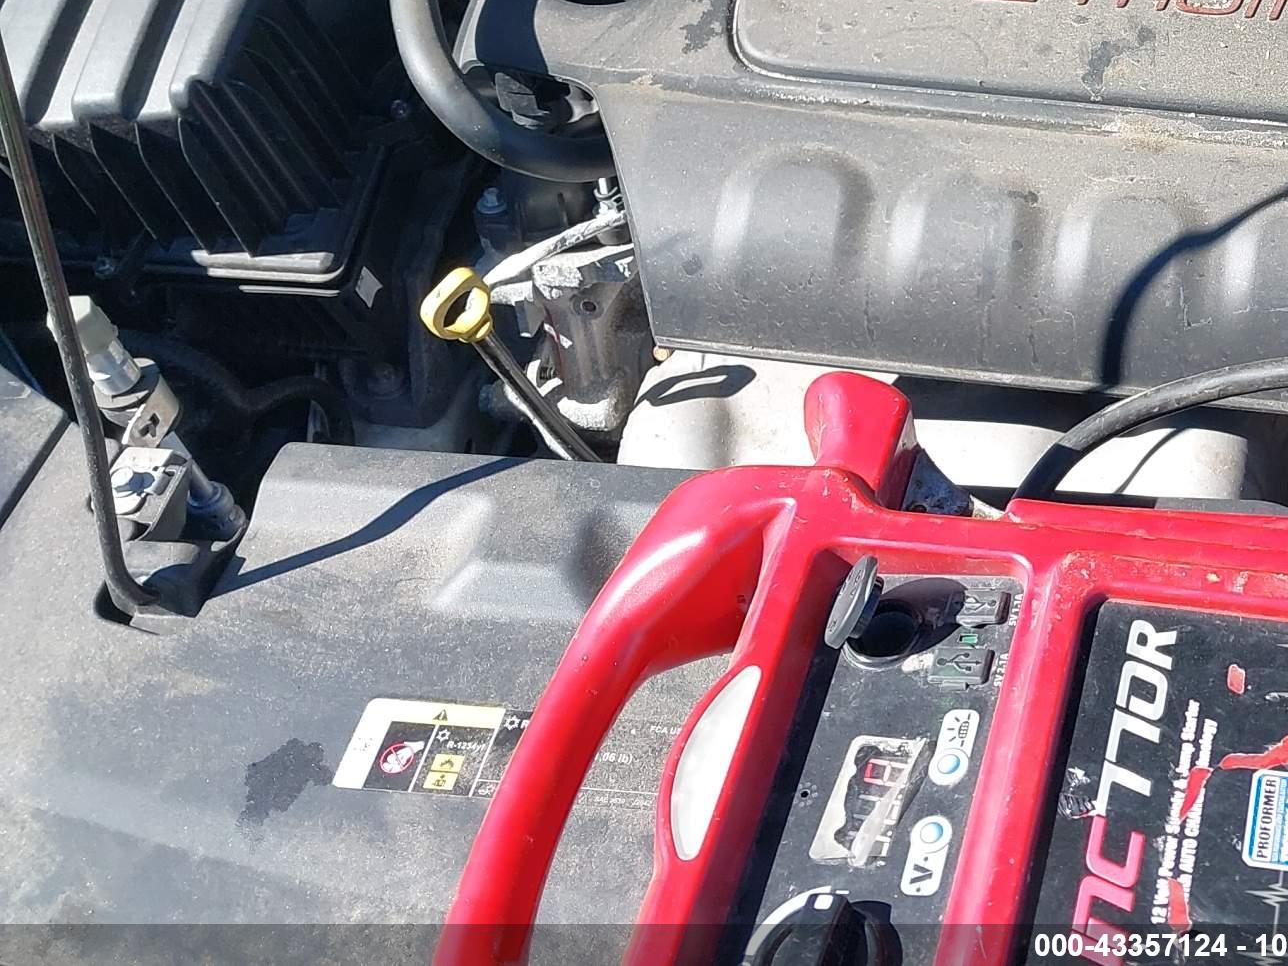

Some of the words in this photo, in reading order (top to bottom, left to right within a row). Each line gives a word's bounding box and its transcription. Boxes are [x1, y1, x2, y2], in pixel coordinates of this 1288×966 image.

[1181, 698, 1201, 742] Starter
[1256, 779, 1278, 859] PROFORMER
[1157, 835, 1180, 877] Power
[1179, 837, 1199, 873] AUTO
[1150, 906, 1168, 925] 12
